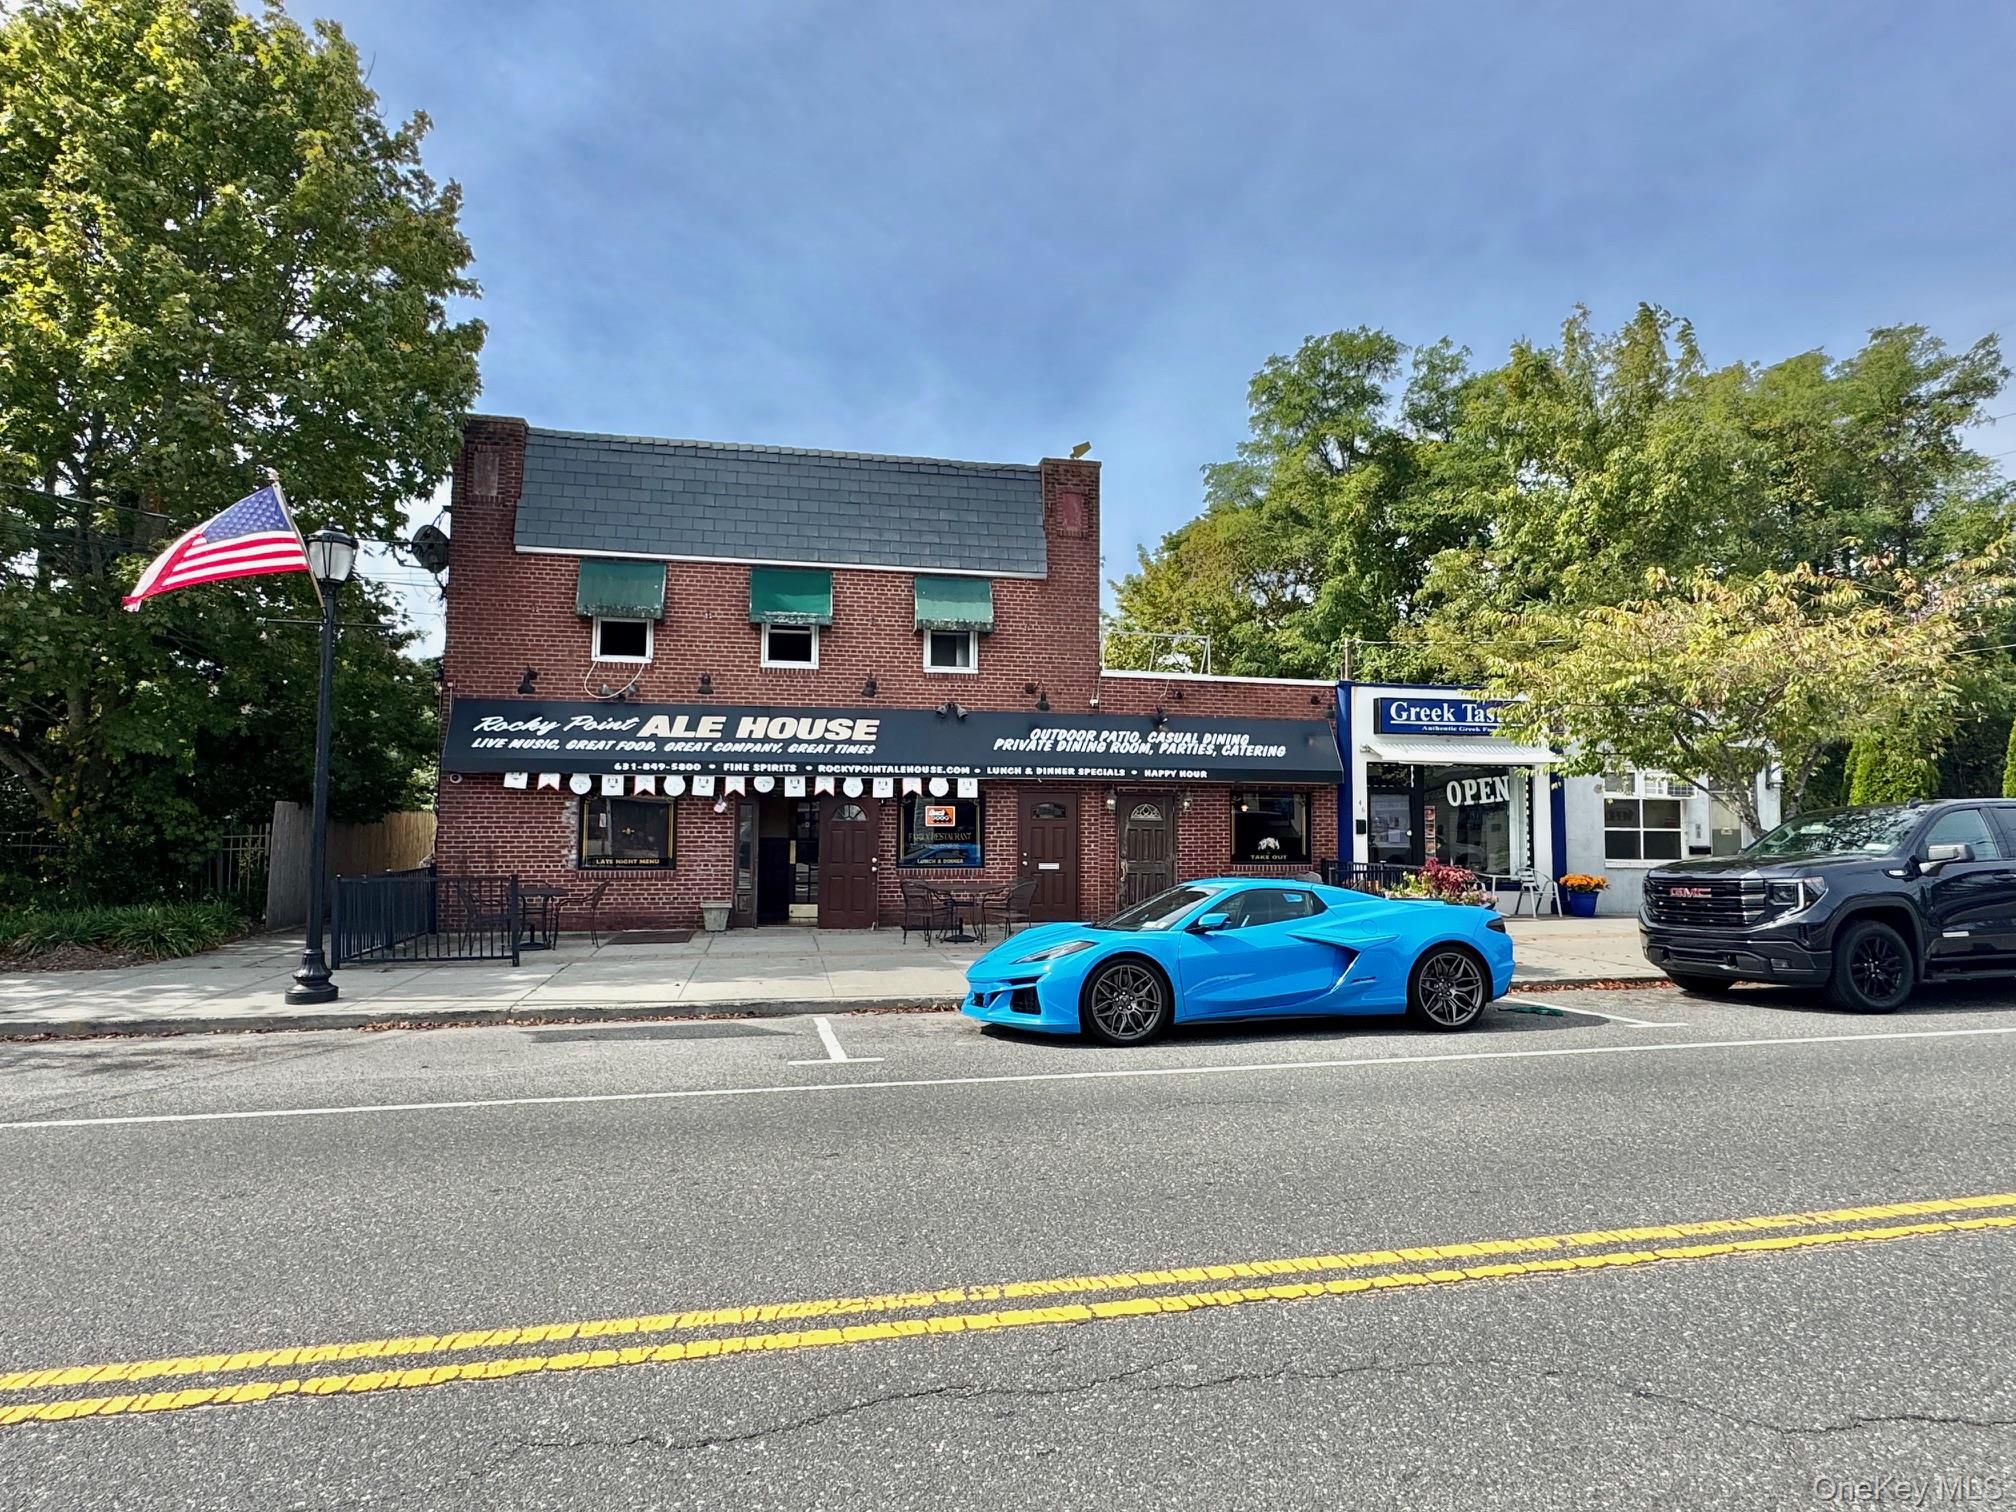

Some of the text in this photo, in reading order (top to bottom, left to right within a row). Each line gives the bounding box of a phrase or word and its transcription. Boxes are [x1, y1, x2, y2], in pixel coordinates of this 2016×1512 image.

[1390, 701, 1504, 723] Greek Tas
[473, 715, 640, 736] Rocky Point
[636, 715, 880, 741] ALE HOUSE
[471, 738, 876, 754] LIVE MUSIC, GREAT FOOD, GREAT COMPANY, GREAT TIMES
[1029, 728, 1250, 747] OUTDOOR PATIO, CASUAL DINING
[993, 738, 1286, 757] PRIVATE DINING ROOM, PARTIES, CATERING
[614, 762, 702, 771] 631-849-5800
[752, 764, 797, 772] SPIRITS
[818, 765, 970, 774] ROCKYPOINTALEHOUSE.COM
[986, 767, 1022, 775] LUNCH
[1025, 767, 1033, 775] &
[1036, 768, 1076, 776] DINNER
[1077, 768, 1126, 776] SPECIALS
[1144, 769, 1177, 778] HAPPY
[1179, 770, 1208, 778] HOUR
[1446, 775, 1511, 807] OPEN
[930, 832, 972, 841] RESTAURANT
[1670, 887, 1711, 897] GMC
